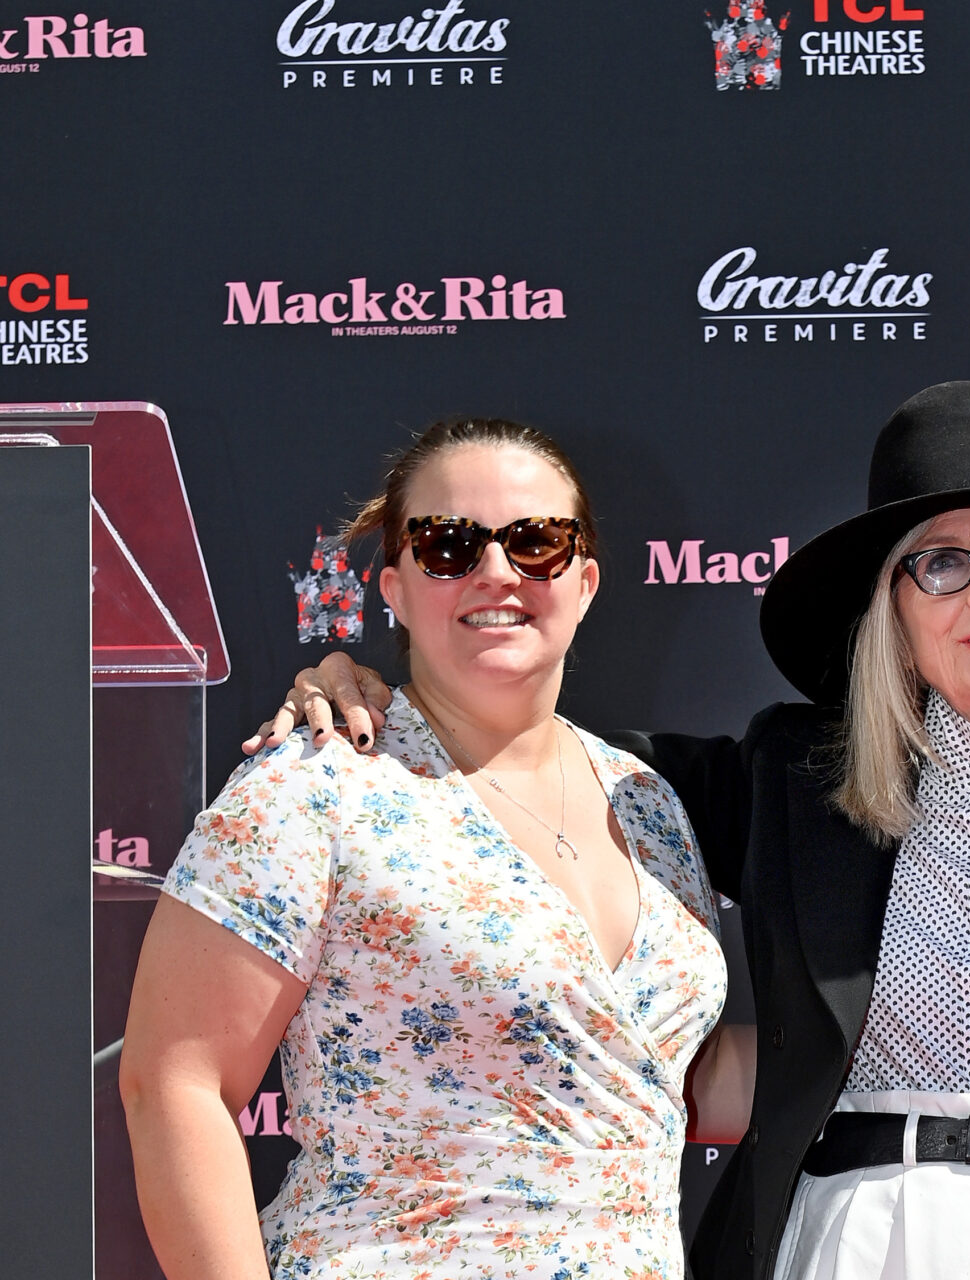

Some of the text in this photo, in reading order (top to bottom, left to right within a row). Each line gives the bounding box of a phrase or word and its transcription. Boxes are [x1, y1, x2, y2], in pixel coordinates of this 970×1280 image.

[276, 0, 511, 58] Gravitas
[800, 30, 925, 54] CHINESE
[29, 63, 40, 72] 12
[800, 54, 926, 76] THEATRES
[283, 66, 504, 88] PREMIERE
[697, 247, 933, 312] Gravitas
[331, 325, 458, 337] IN THEATERS AUGUST 12
[704, 322, 927, 343] PREMIERE
